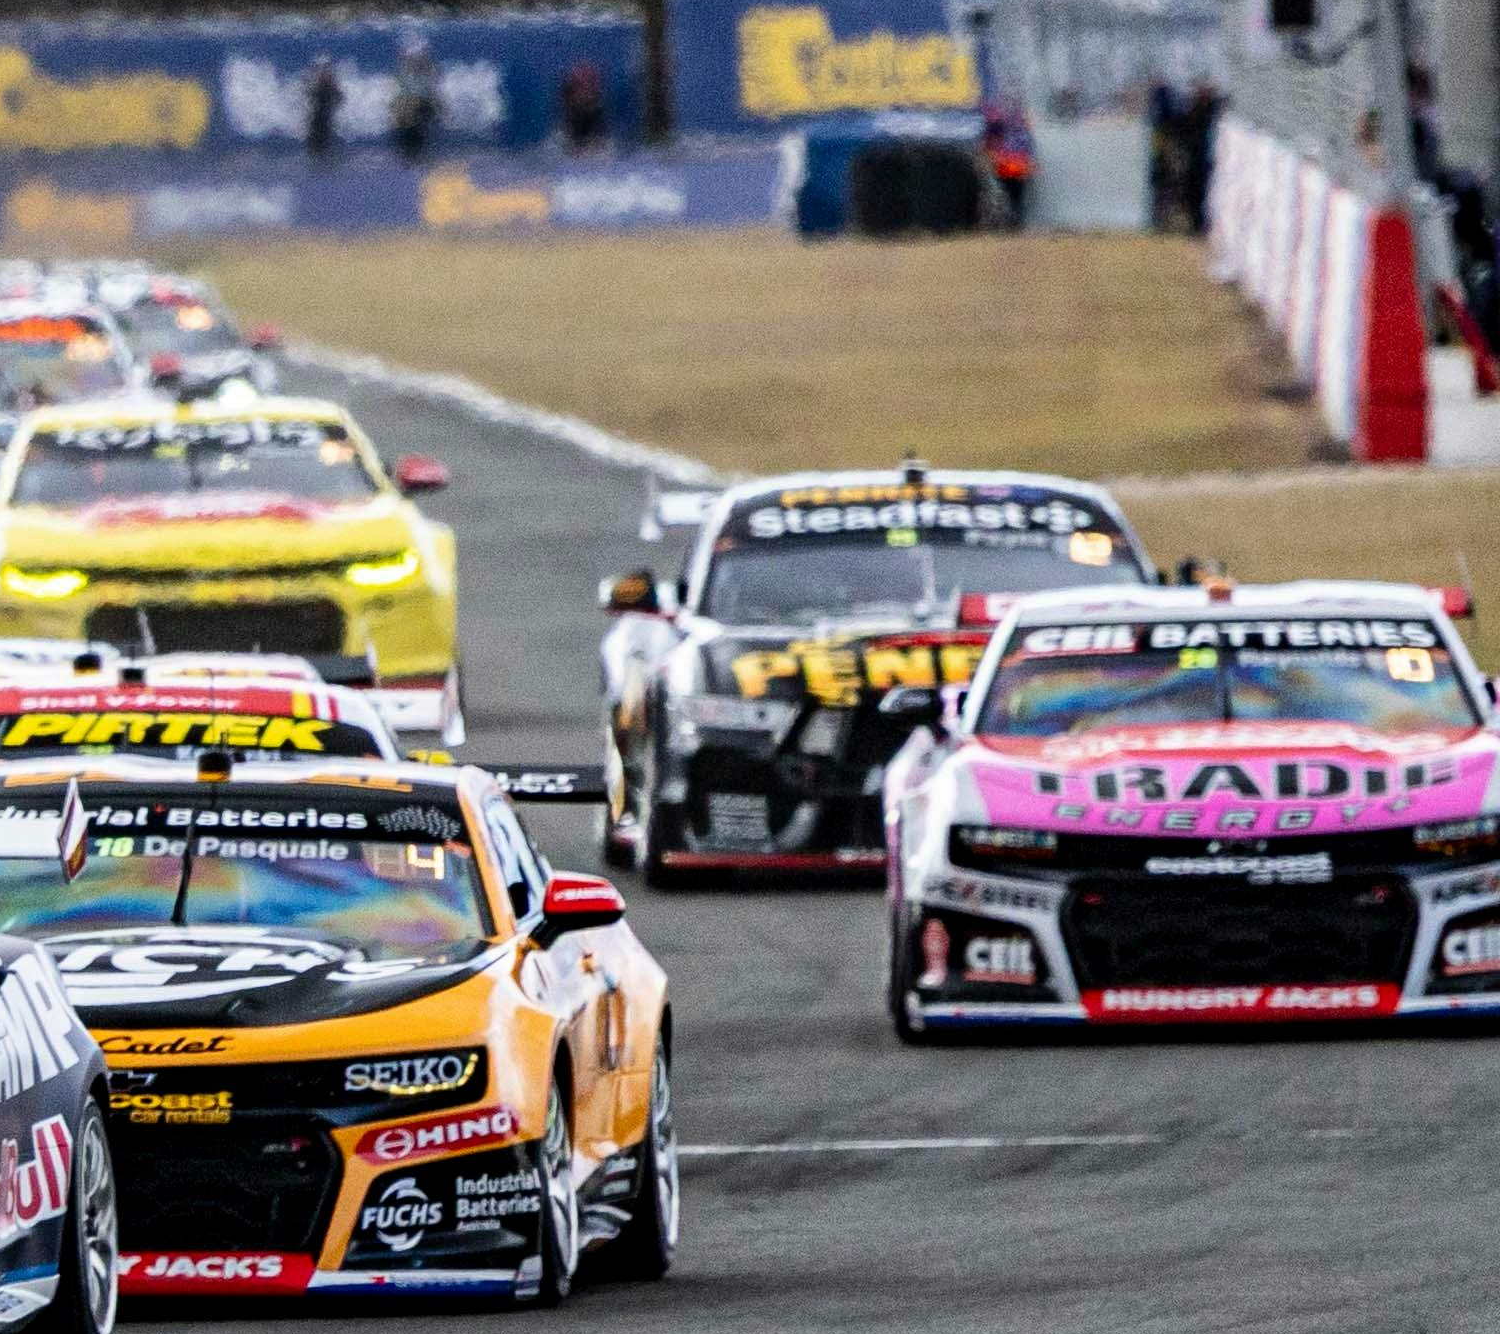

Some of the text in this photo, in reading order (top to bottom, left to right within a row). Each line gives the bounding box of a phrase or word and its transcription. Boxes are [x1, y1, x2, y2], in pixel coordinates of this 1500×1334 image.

[748, 502, 1026, 539] Steadfast
[1150, 620, 1438, 650] BATTERIES
[2, 713, 338, 751] PIRTEK
[166, 806, 368, 830] Batteries
[344, 1056, 463, 1092] SEIKO
[416, 1110, 513, 1149] HINO
[456, 1169, 542, 1196] Industrial
[361, 1202, 444, 1230] FUCHS
[456, 1195, 542, 1218] Batteries
